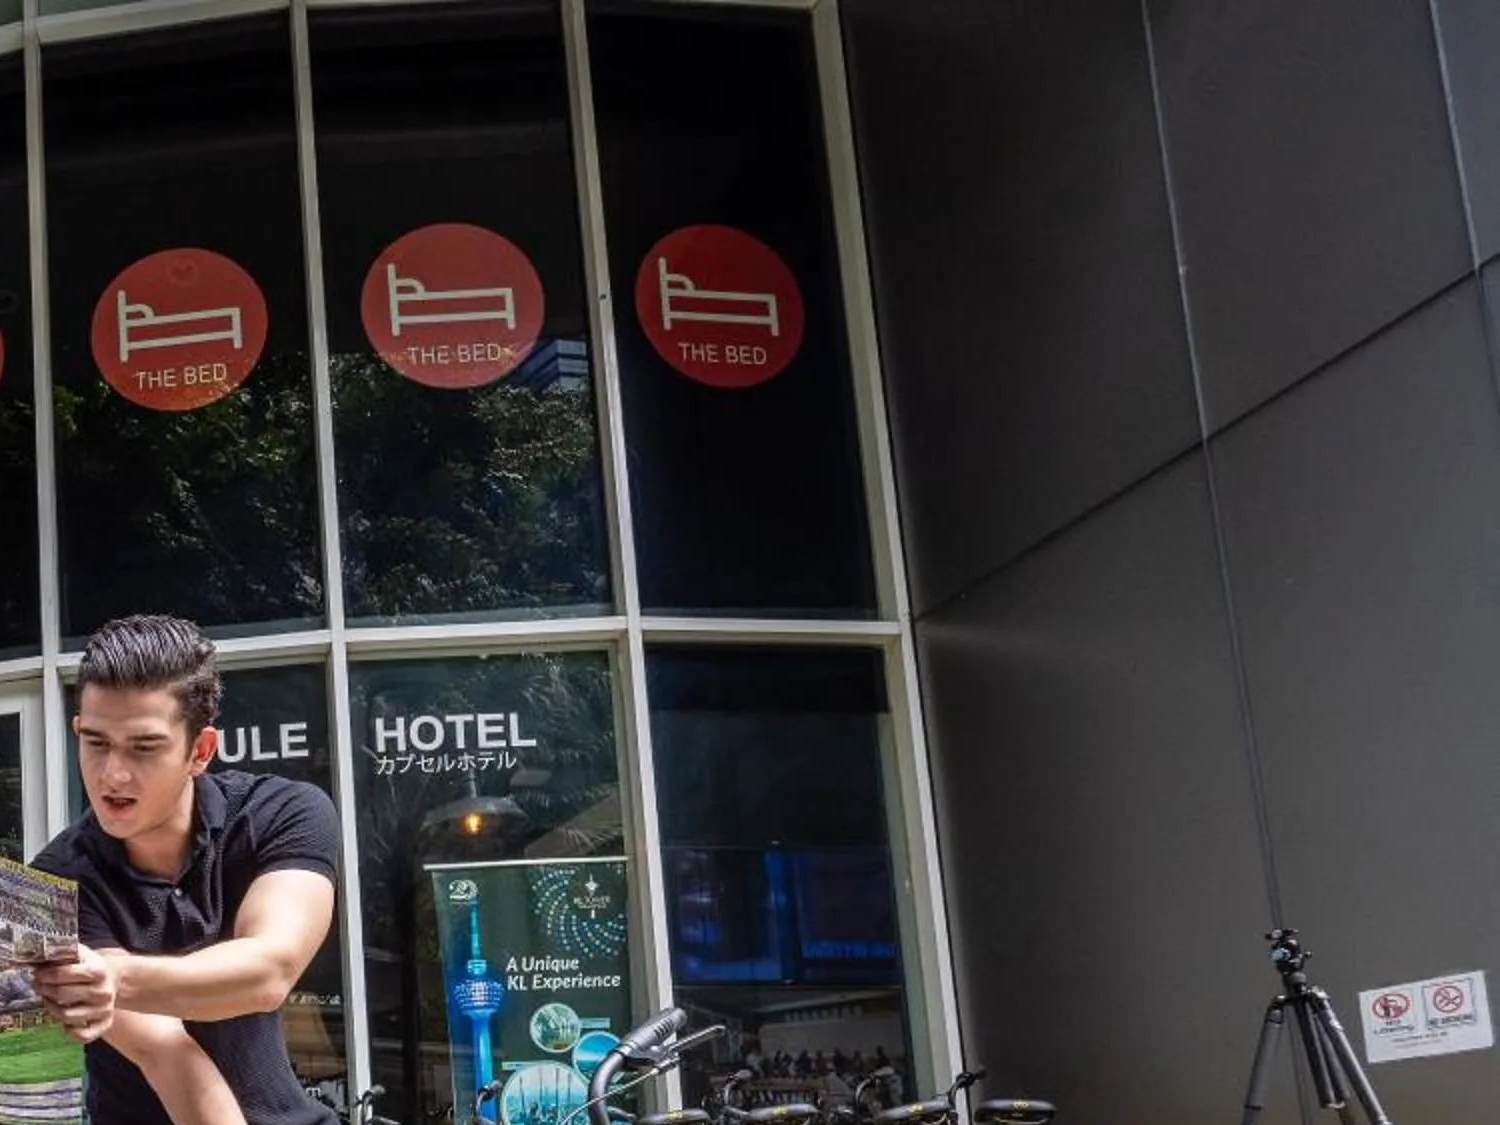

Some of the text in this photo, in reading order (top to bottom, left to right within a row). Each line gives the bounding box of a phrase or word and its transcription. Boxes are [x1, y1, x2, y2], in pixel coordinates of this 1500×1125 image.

[407, 343, 501, 365] THE BED
[678, 342, 767, 365] THE BED
[136, 363, 227, 390] THE BED
[216, 713, 537, 763] ULE HOTEL
[505, 956, 580, 974] A Unique
[507, 973, 621, 991] KL Experience
